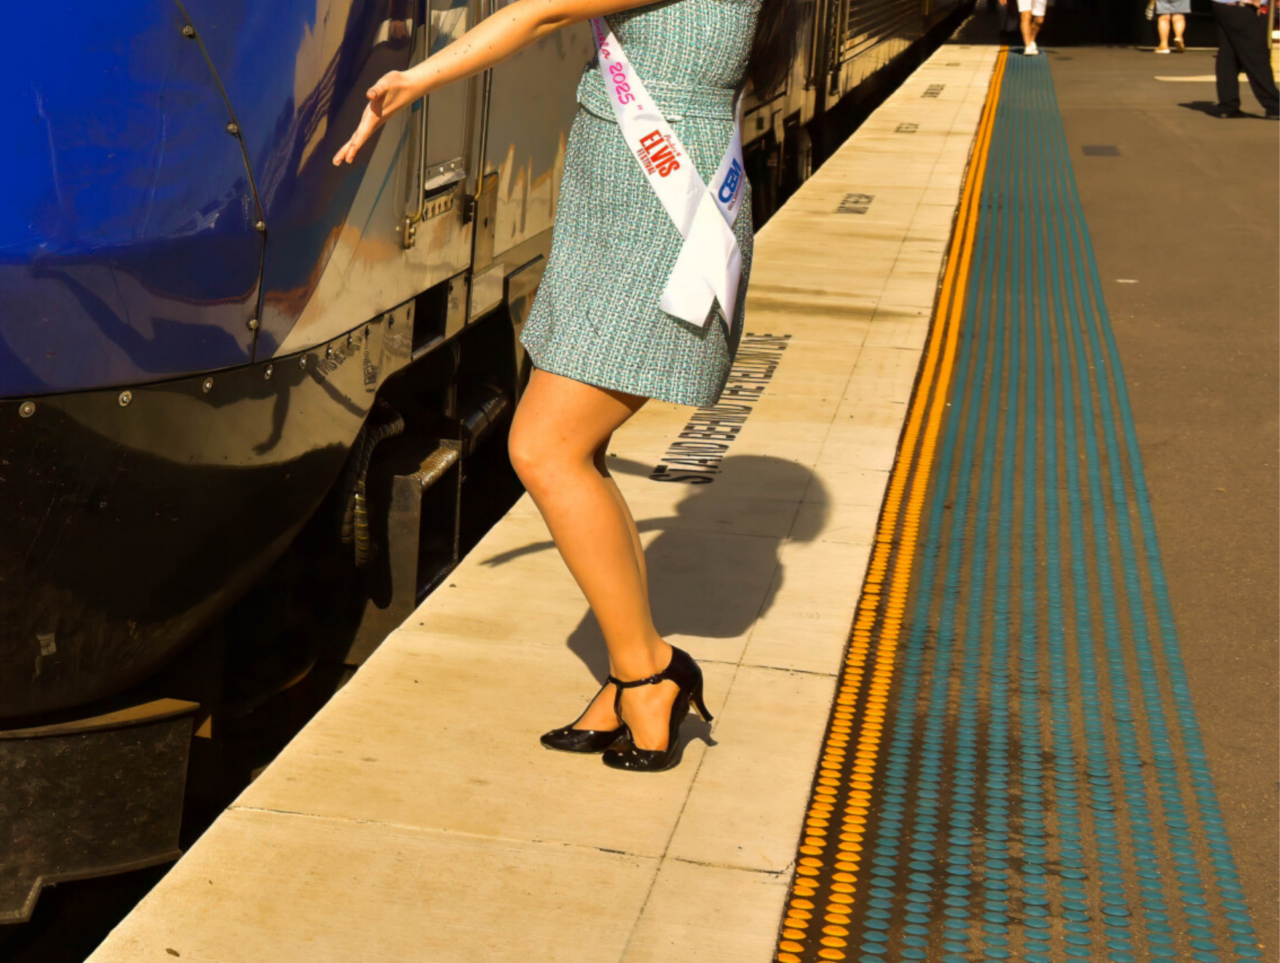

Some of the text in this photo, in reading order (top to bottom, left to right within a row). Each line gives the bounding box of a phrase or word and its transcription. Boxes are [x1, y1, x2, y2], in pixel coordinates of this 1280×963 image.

[608, 61, 636, 105] 2025
[635, 147, 657, 177] FESTIVAL
[638, 129, 681, 179] ELVIS
[678, 402, 754, 441] BEHIND
[648, 440, 730, 485] STAND
